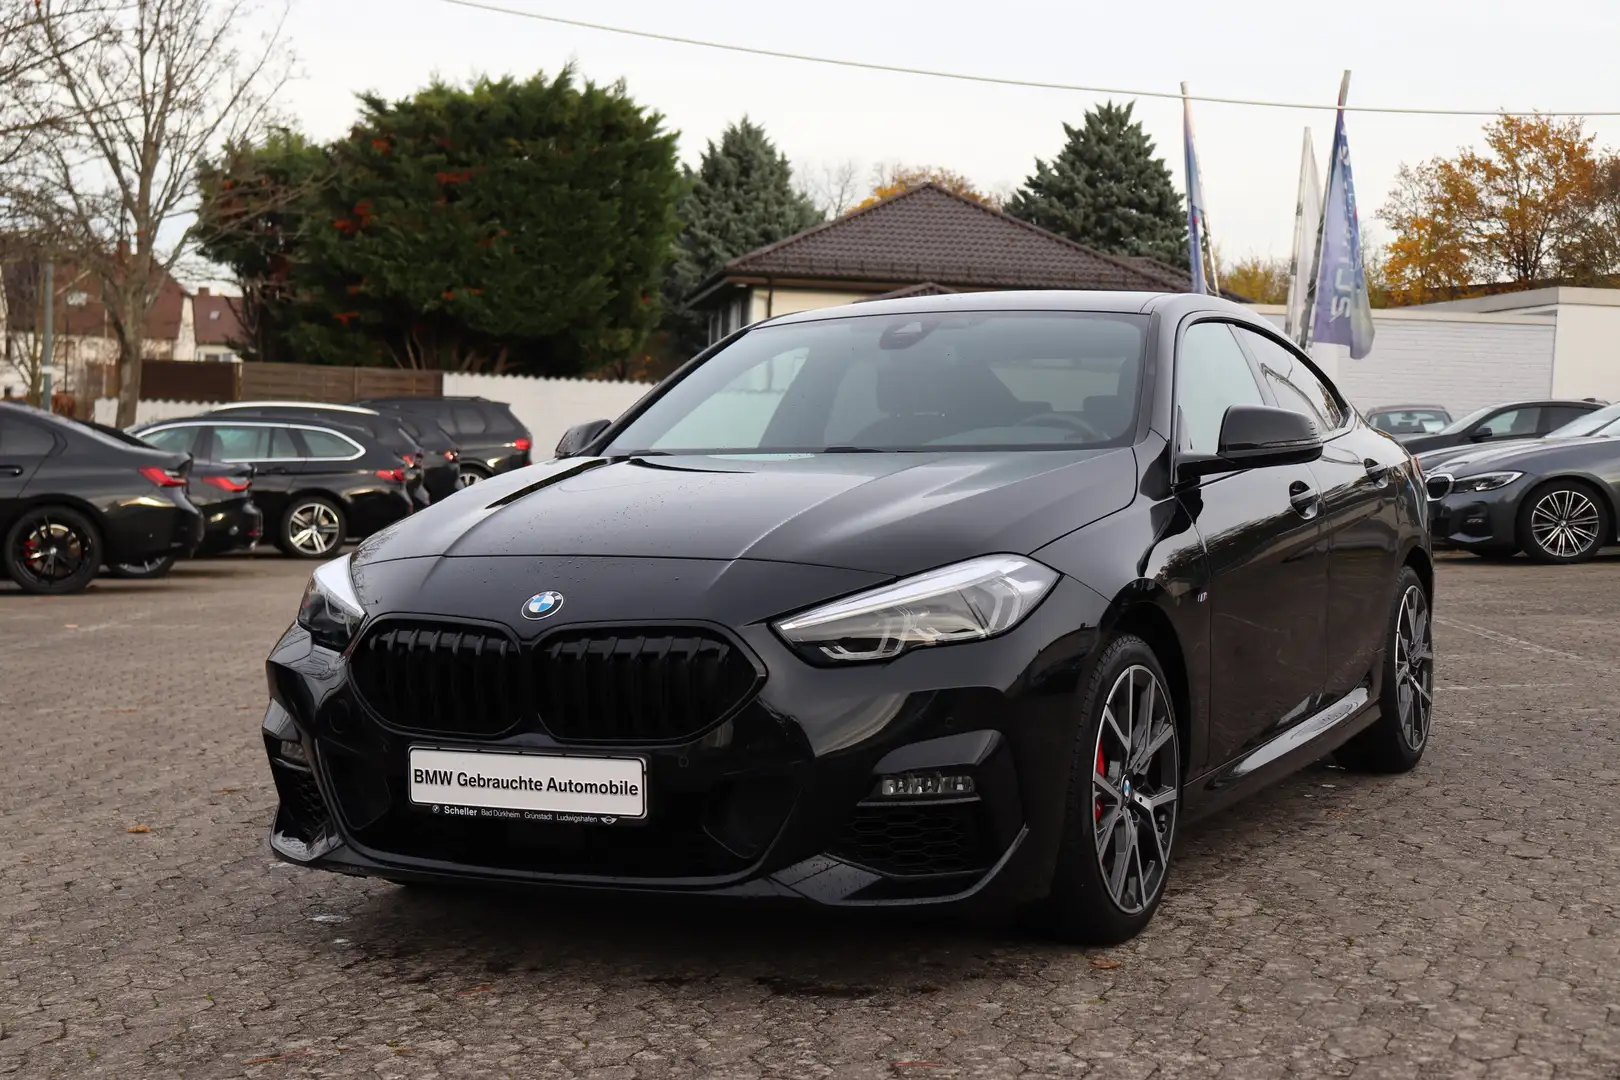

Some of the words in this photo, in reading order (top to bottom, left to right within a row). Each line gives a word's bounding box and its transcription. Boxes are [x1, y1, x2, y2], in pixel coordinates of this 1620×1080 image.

[413, 768, 453, 786] BMW
[457, 772, 543, 791] Gebrauchte
[546, 777, 639, 796] Automobile
[444, 806, 478, 816] Scheller
[481, 808, 493, 817] Bad
[493, 808, 521, 819] Dürkheim
[524, 811, 553, 821] Grünstadt
[556, 814, 598, 824] Ludwigshafen
